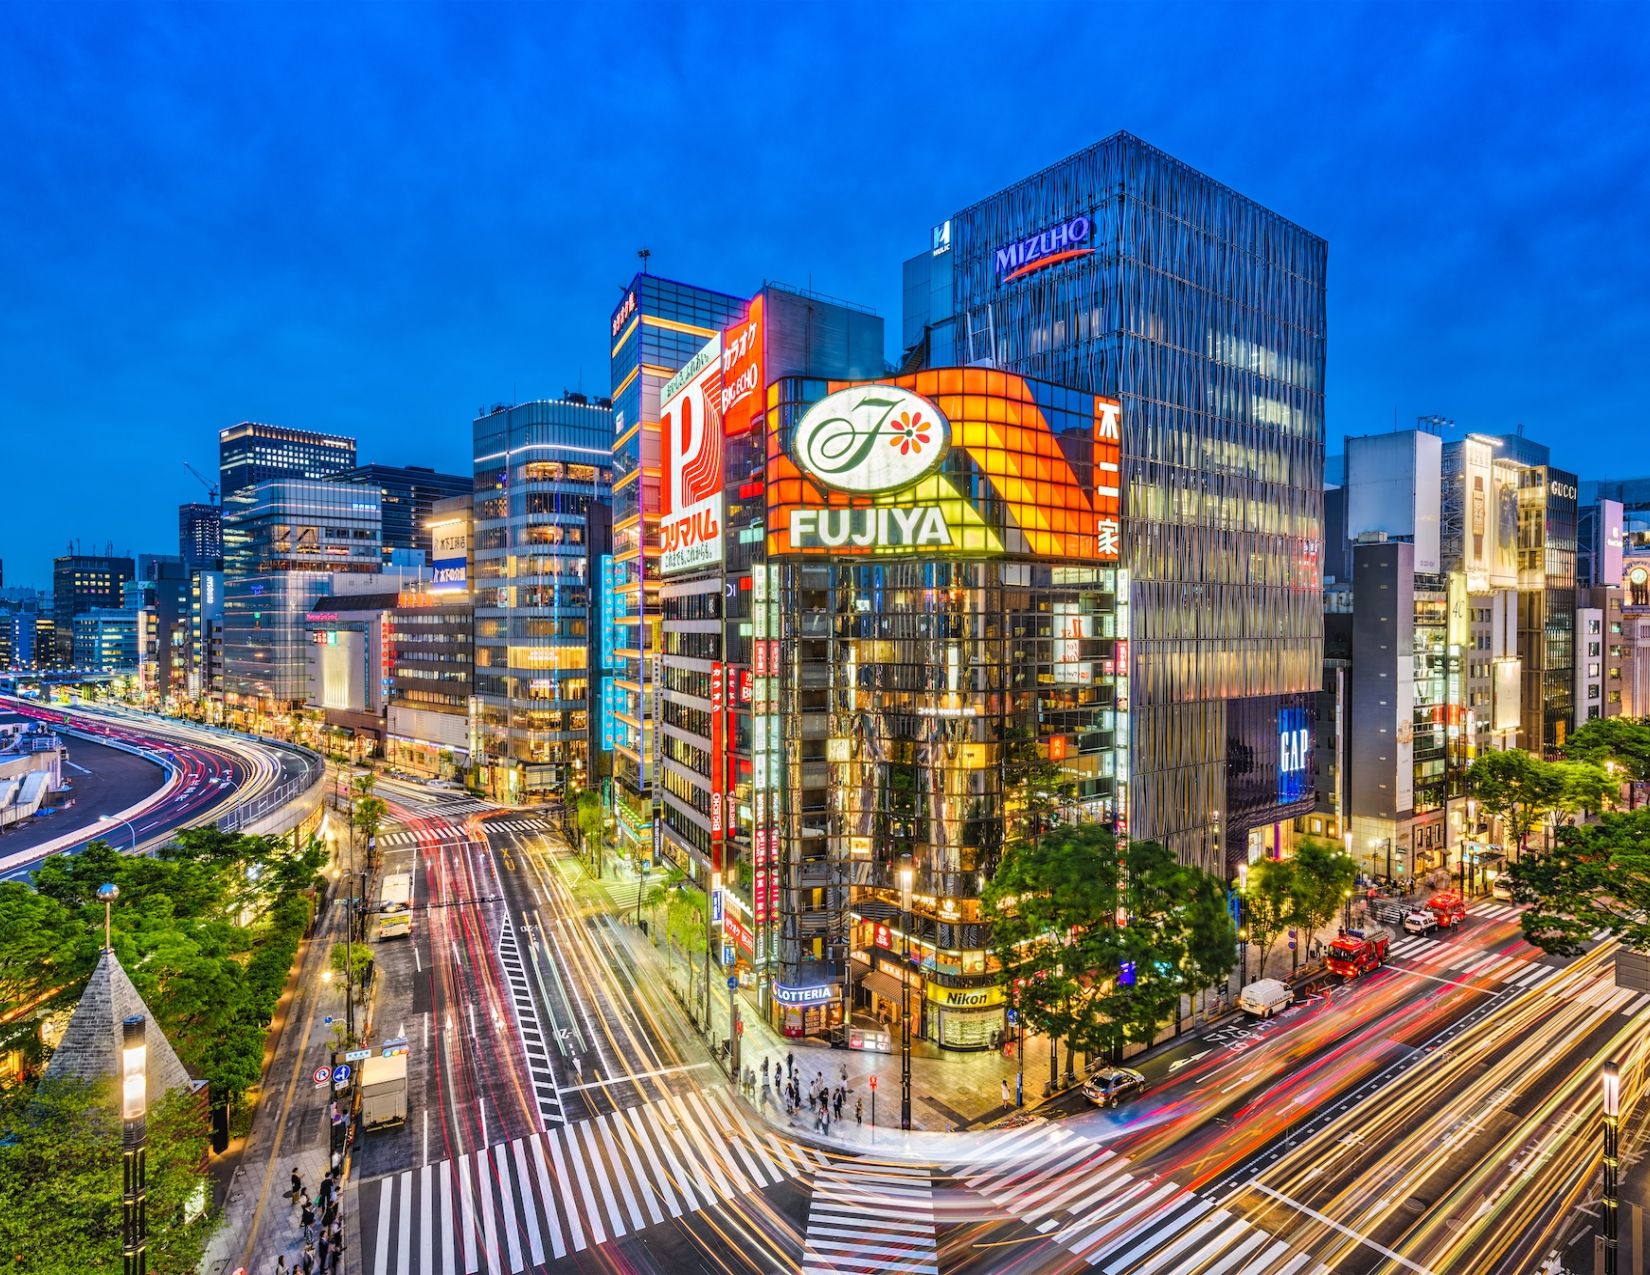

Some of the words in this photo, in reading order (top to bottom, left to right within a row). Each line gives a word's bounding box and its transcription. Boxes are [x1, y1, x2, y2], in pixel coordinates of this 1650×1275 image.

[996, 216, 1090, 273] MIZUHO
[723, 322, 757, 374] カラオケ
[721, 382, 736, 415] BIG
[736, 363, 758, 395] ECHO
[1098, 402, 1120, 555] 不二家
[1551, 480, 1577, 500] GUCCI
[660, 508, 718, 554] プリマハム
[789, 506, 952, 548] FUJIYA
[712, 668, 721, 712] カラオケ
[1281, 729, 1308, 772] GAP
[712, 792, 720, 815] ECHO
[712, 815, 720, 831] BIG
[777, 986, 832, 1002] LOTTERIA
[946, 992, 987, 1006] Nikon
